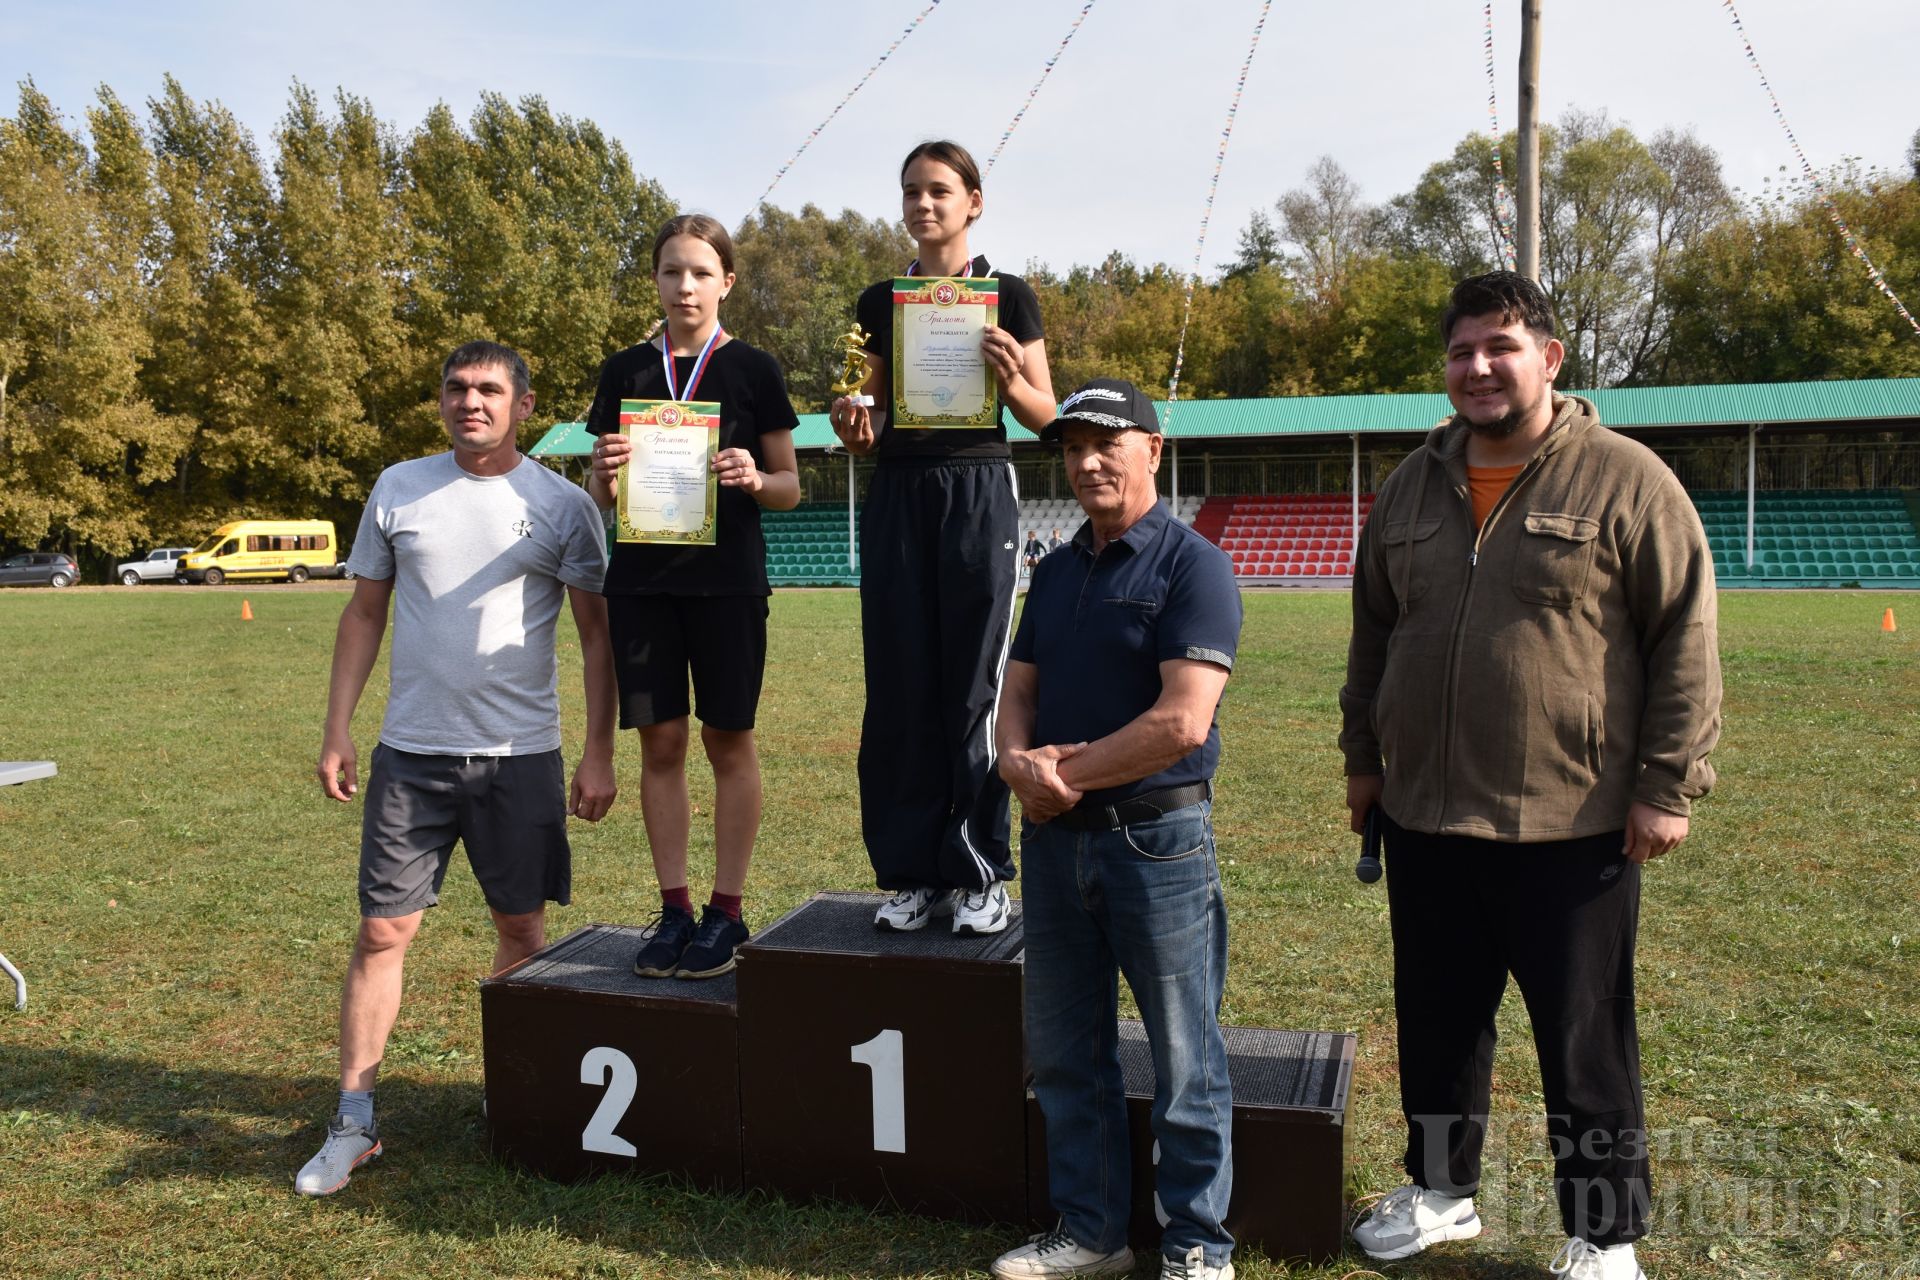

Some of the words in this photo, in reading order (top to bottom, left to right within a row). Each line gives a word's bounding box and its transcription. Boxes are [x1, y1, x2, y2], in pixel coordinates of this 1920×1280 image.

[919, 311, 966, 325] Грамота
[580, 1046, 637, 1157] 2
[851, 1029, 905, 1153] 1
